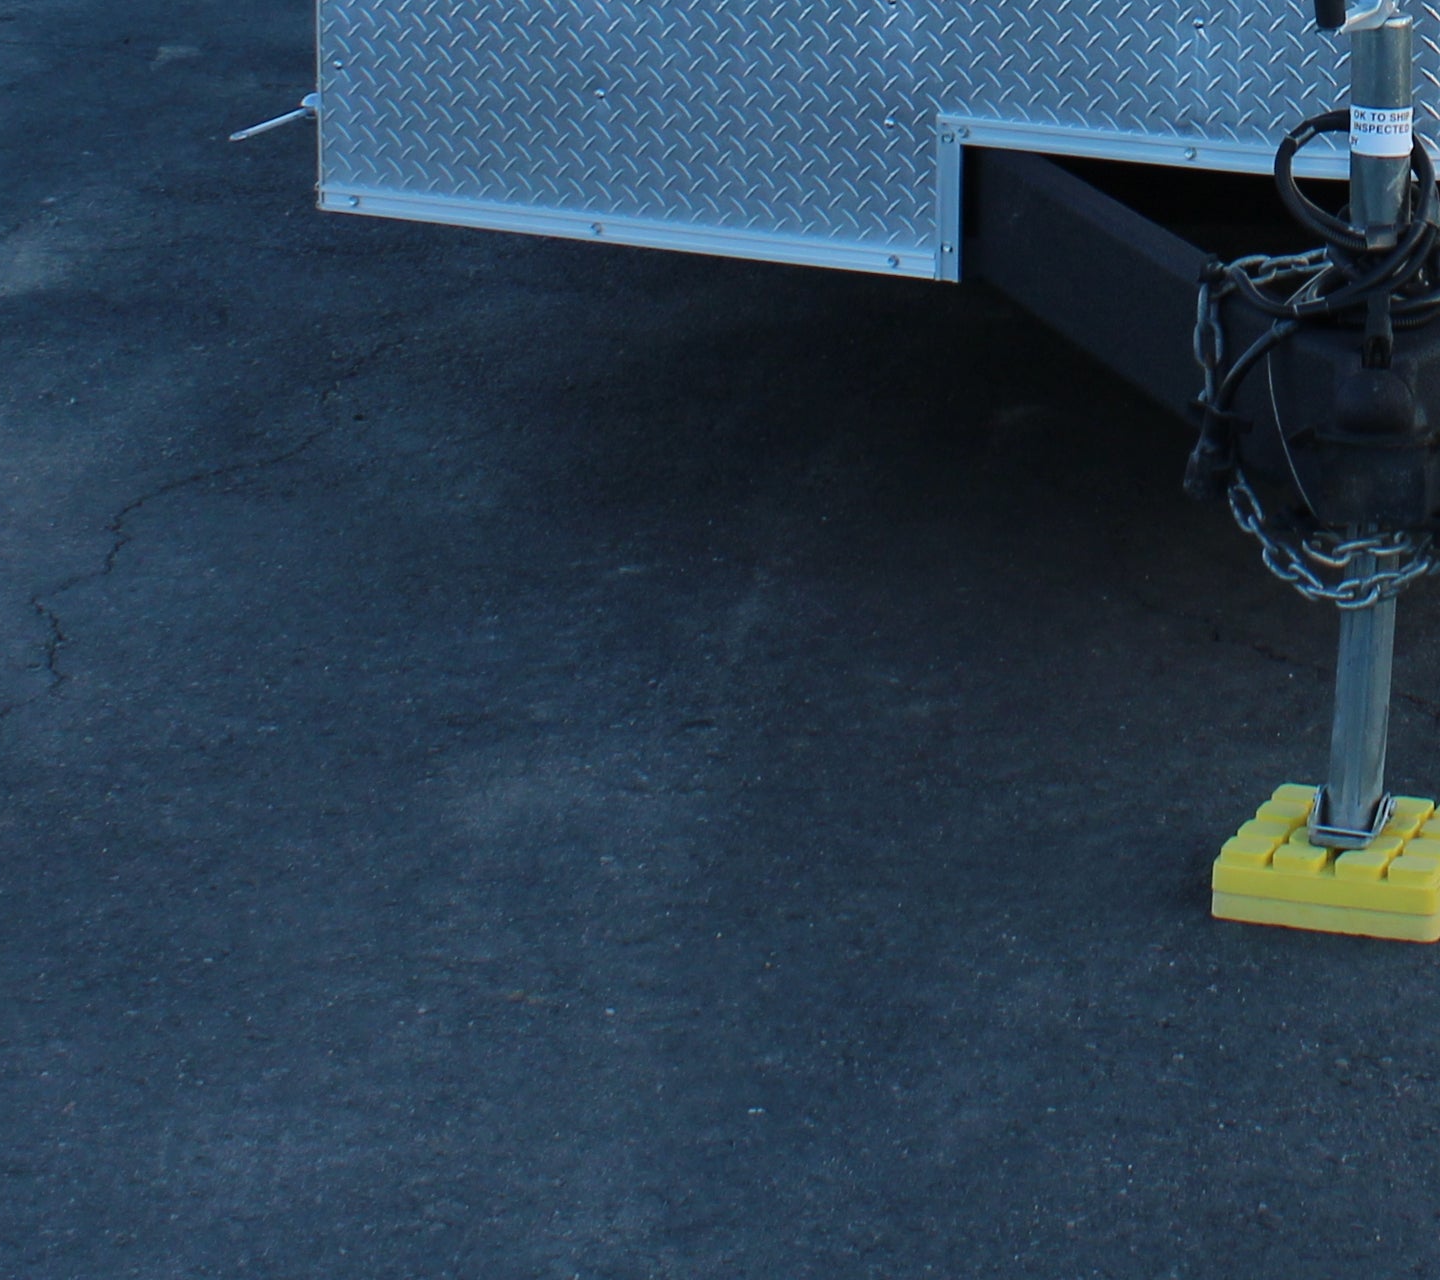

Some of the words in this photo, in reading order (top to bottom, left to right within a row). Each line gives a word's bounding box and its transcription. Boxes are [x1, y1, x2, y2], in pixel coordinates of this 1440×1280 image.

[1353, 109, 1367, 120] OK
[1371, 112, 1386, 122] TO
[1353, 121, 1410, 135] INSPECTED
